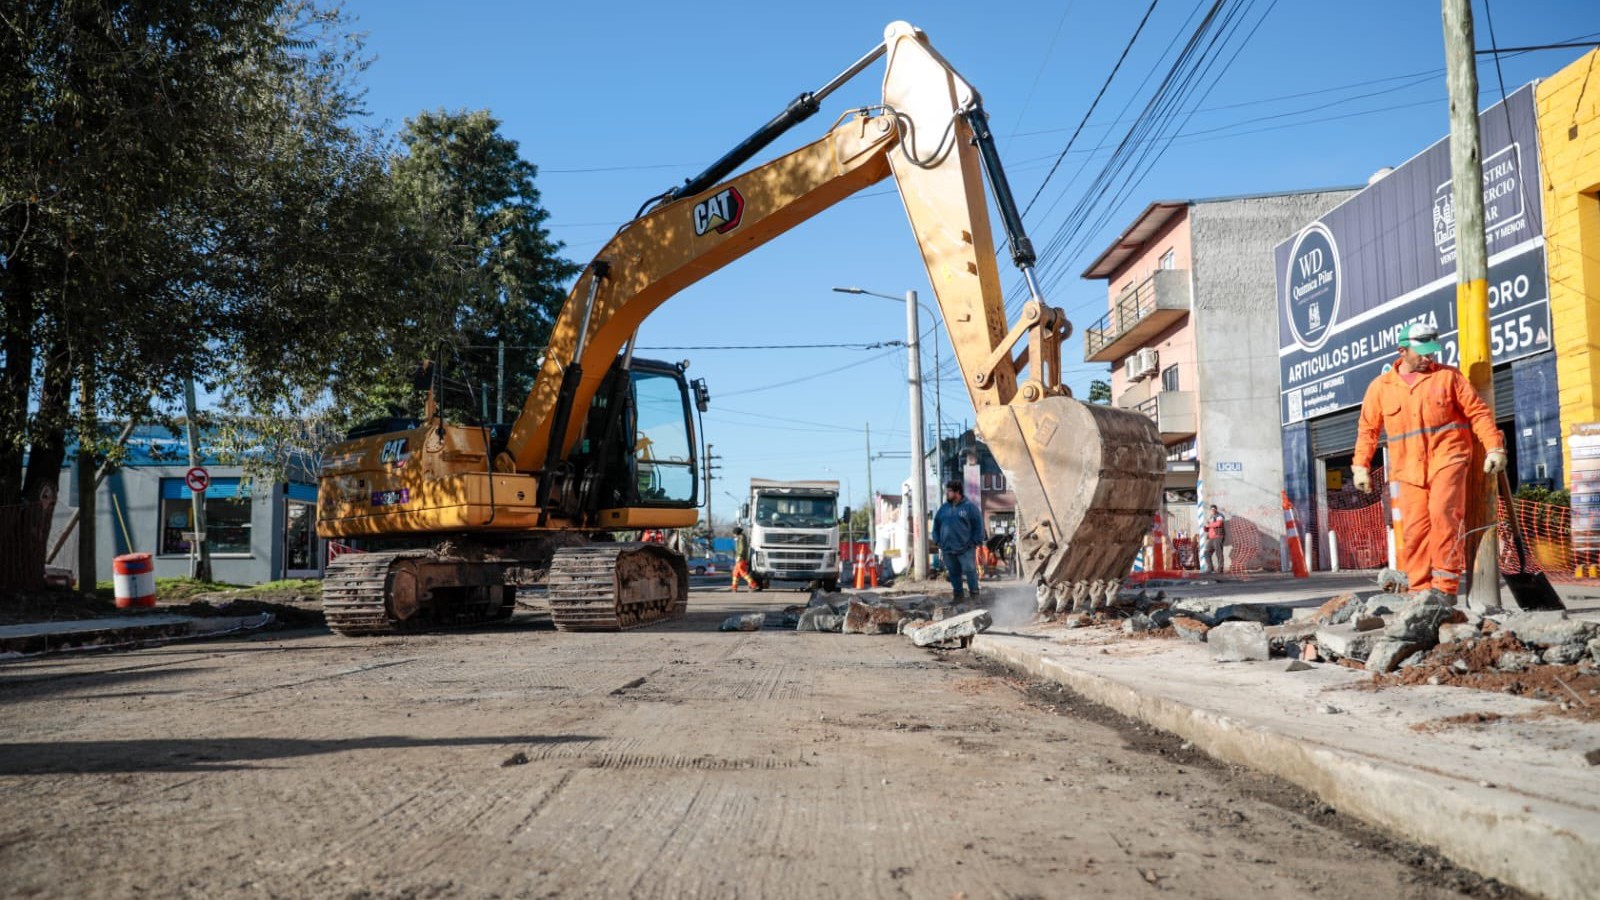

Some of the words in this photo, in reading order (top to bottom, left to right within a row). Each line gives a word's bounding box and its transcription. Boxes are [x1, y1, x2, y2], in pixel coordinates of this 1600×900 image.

[1483, 160, 1514, 186] STRIA
[1483, 178, 1515, 204] ERCIO
[694, 189, 730, 235] CAT
[1501, 219, 1526, 238] MENOR
[1298, 248, 1323, 280] WD
[1318, 270, 1334, 287] Pilar
[1288, 345, 1349, 384] ARTICULOS
[1352, 337, 1368, 360] DE
[1371, 310, 1438, 352] LIMPZA
[1488, 275, 1529, 309] ORO
[1491, 314, 1533, 356] 555
[382, 438, 406, 463] CAT
